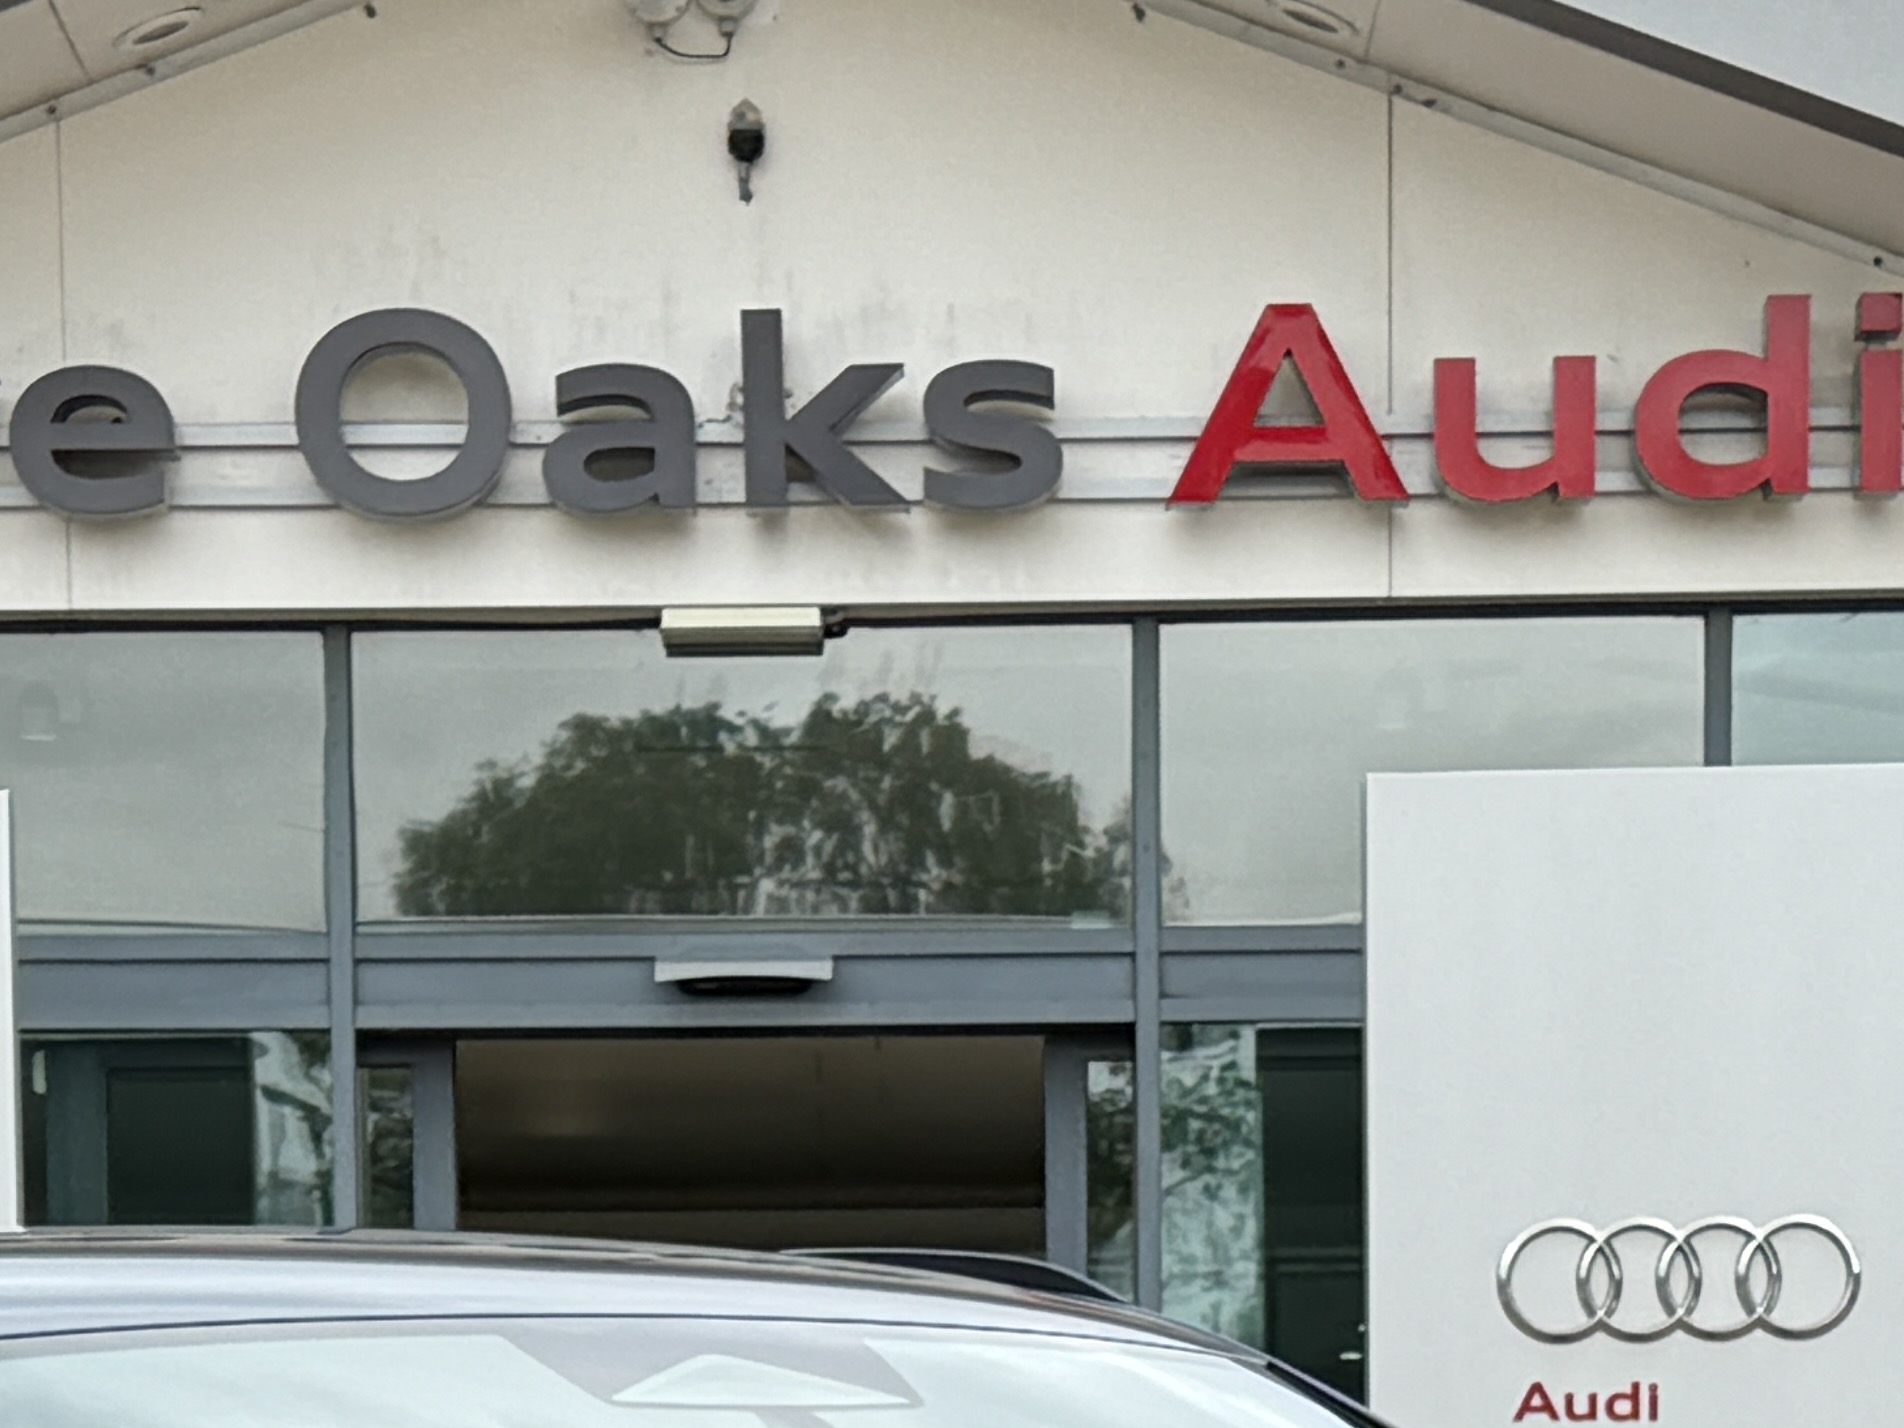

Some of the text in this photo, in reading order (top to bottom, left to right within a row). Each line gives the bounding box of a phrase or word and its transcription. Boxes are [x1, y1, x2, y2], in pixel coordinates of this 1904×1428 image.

[296, 307, 1063, 514] Oaks
[1169, 293, 1904, 506] Audi
[1512, 1381, 1660, 1422] Audi
